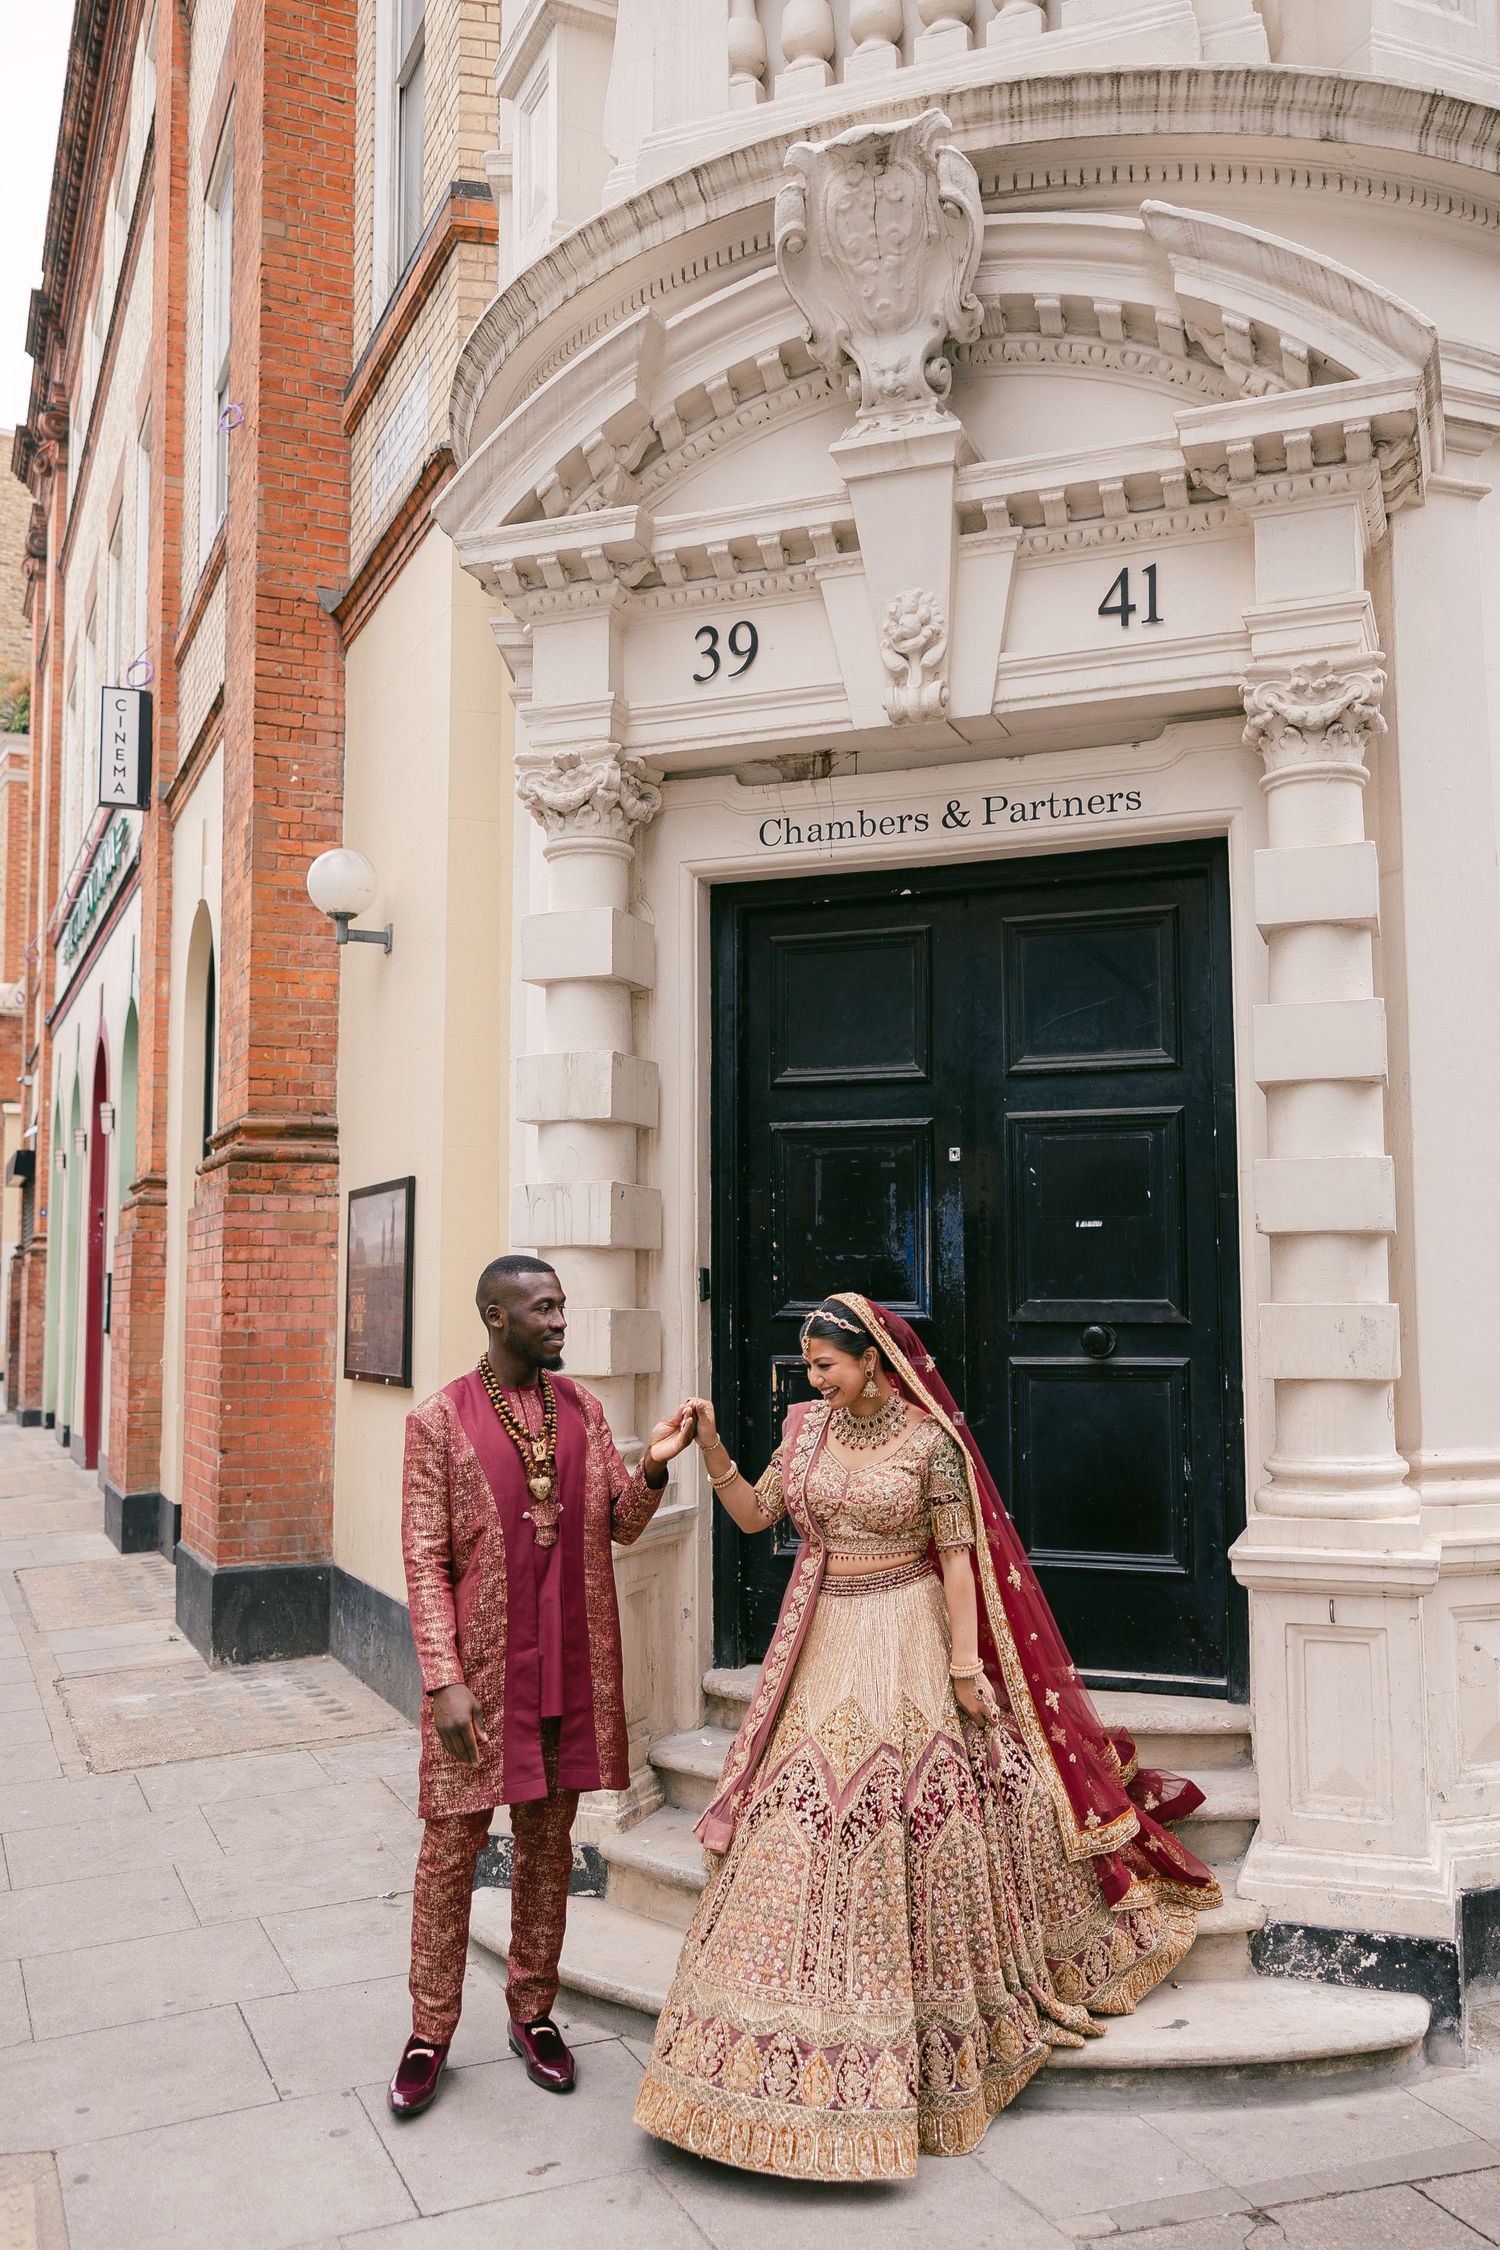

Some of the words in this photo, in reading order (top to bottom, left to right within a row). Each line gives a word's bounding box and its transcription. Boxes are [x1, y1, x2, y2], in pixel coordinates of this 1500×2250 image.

[1098, 563, 1164, 627] 41
[692, 620, 759, 683] 39
[113, 698, 127, 794] CINEMA
[759, 808, 929, 847] Chambers
[941, 799, 972, 829] &
[981, 788, 1142, 826] Partners
